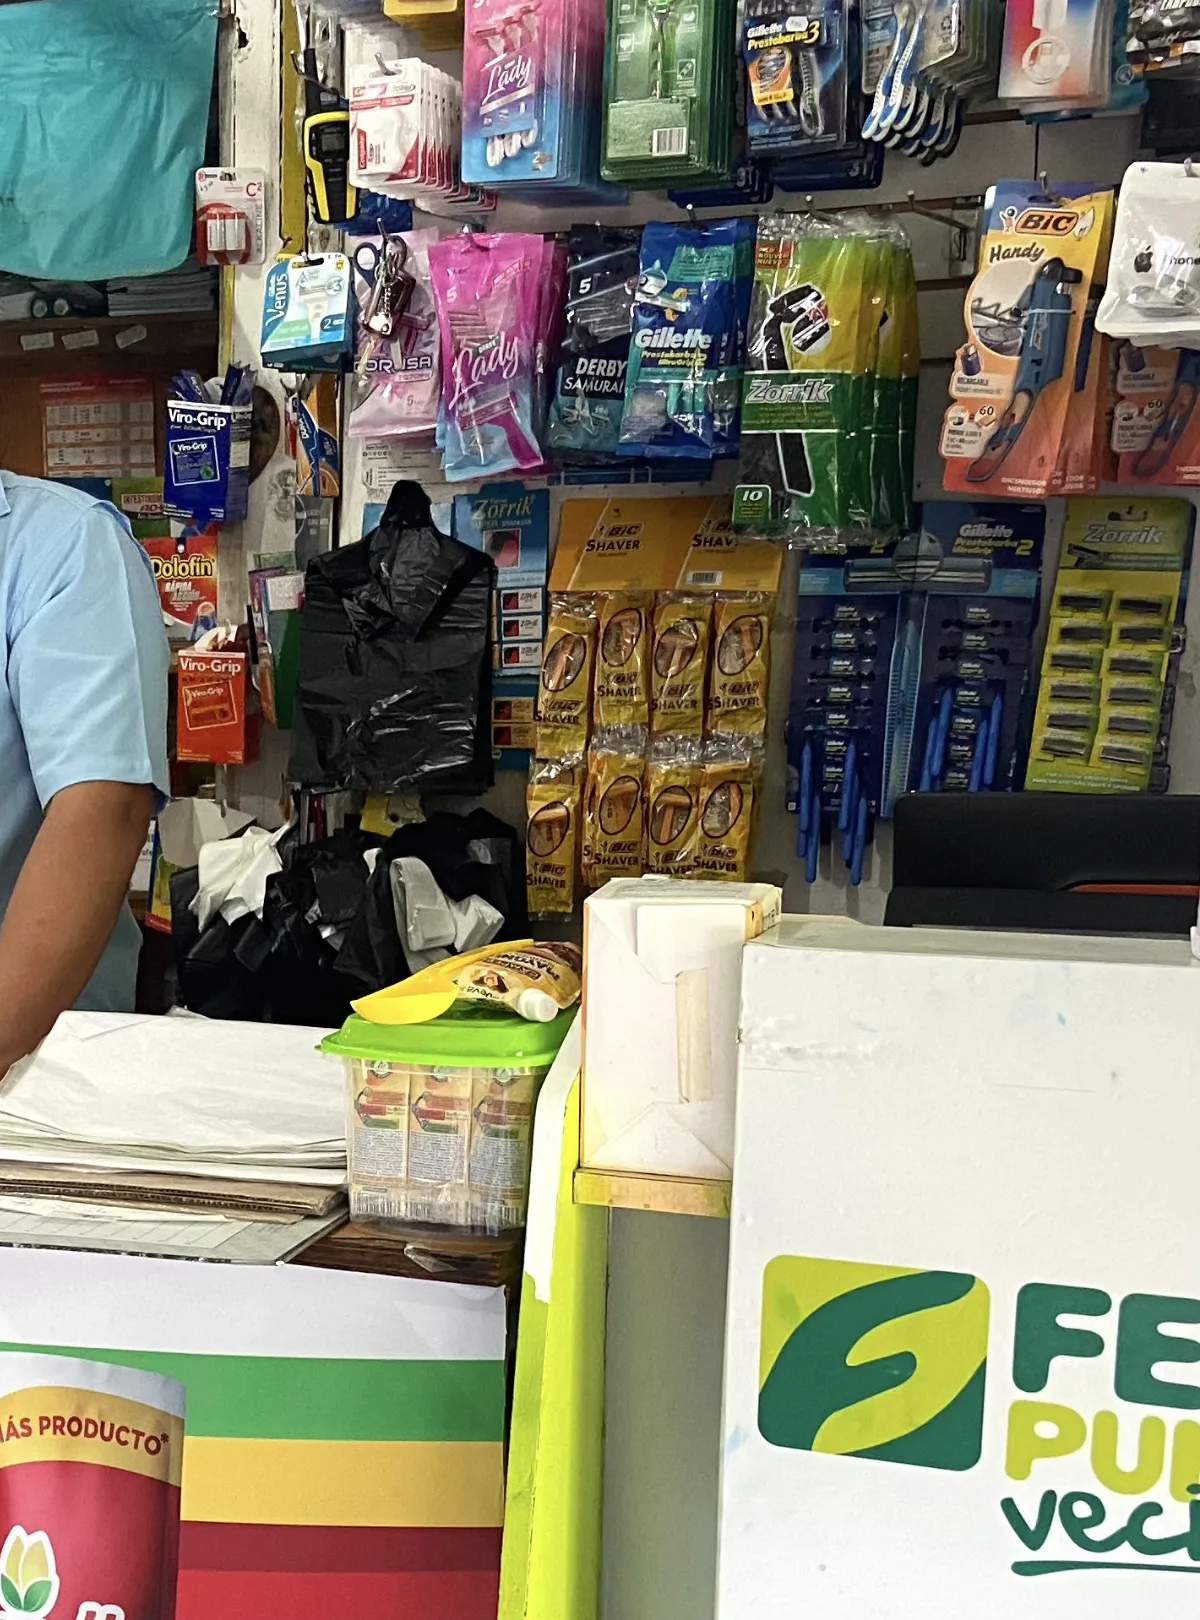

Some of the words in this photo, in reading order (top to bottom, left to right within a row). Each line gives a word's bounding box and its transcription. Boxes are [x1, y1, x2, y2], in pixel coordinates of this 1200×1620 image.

[1020, 214, 1076, 233] BIC
[989, 243, 1045, 263] Handy
[579, 277, 591, 294] 5
[265, 273, 288, 327] Venus
[634, 326, 712, 349] Gillette
[575, 358, 628, 378] DERBY
[745, 379, 836, 404] Zorrik
[168, 408, 227, 431] Viro-Grip
[979, 406, 994, 416] 60
[742, 490, 763, 501] 10
[608, 525, 639, 537] BIC
[959, 523, 1014, 539] Gillette
[1084, 524, 1164, 544] Zorrik
[585, 539, 641, 552] SHAVER
[691, 534, 738, 548] SHAV
[1015, 540, 1035, 556] 2
[179, 657, 242, 677] Viro-Grip
[611, 842, 637, 853] BIC
[593, 852, 639, 866] SHAVER
[693, 856, 738, 873] SHAVER
[526, 873, 567, 889] SHAVER
